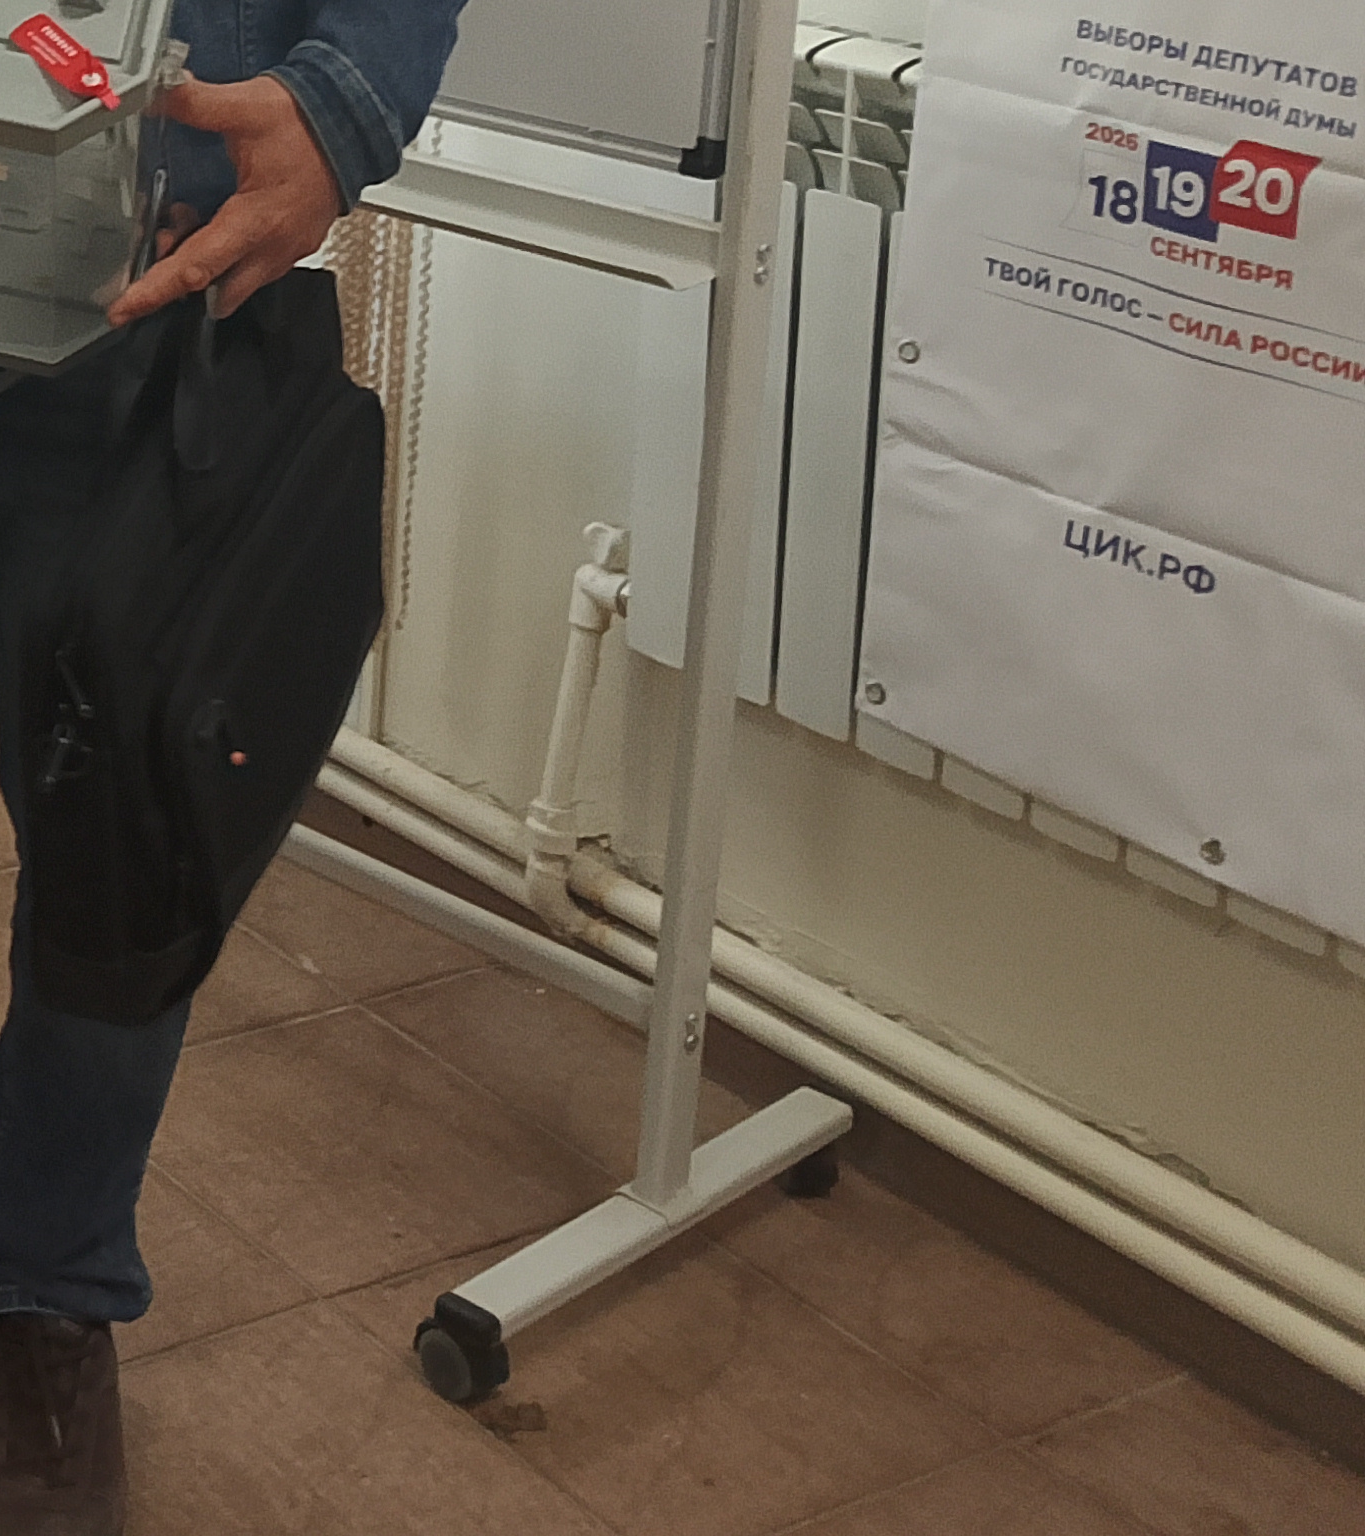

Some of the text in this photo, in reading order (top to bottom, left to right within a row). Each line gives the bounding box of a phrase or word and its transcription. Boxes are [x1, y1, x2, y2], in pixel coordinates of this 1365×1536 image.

[1060, 55, 1358, 139] ГОСУДАРСТВЕННОЙ ДУМЫ
[1076, 18, 1358, 98] ВЫБОРЫ ДЕПУТАТОВ
[1088, 159, 1295, 225] 18 19 20
[1149, 235, 1295, 292] СЕНТЯБРЯ
[984, 256, 1052, 291] ТВОЙ
[1056, 278, 1145, 320] ГОЛОС
[1168, 311, 1244, 352] СИЛА
[1064, 518, 1217, 595] ЦИК.РФ
